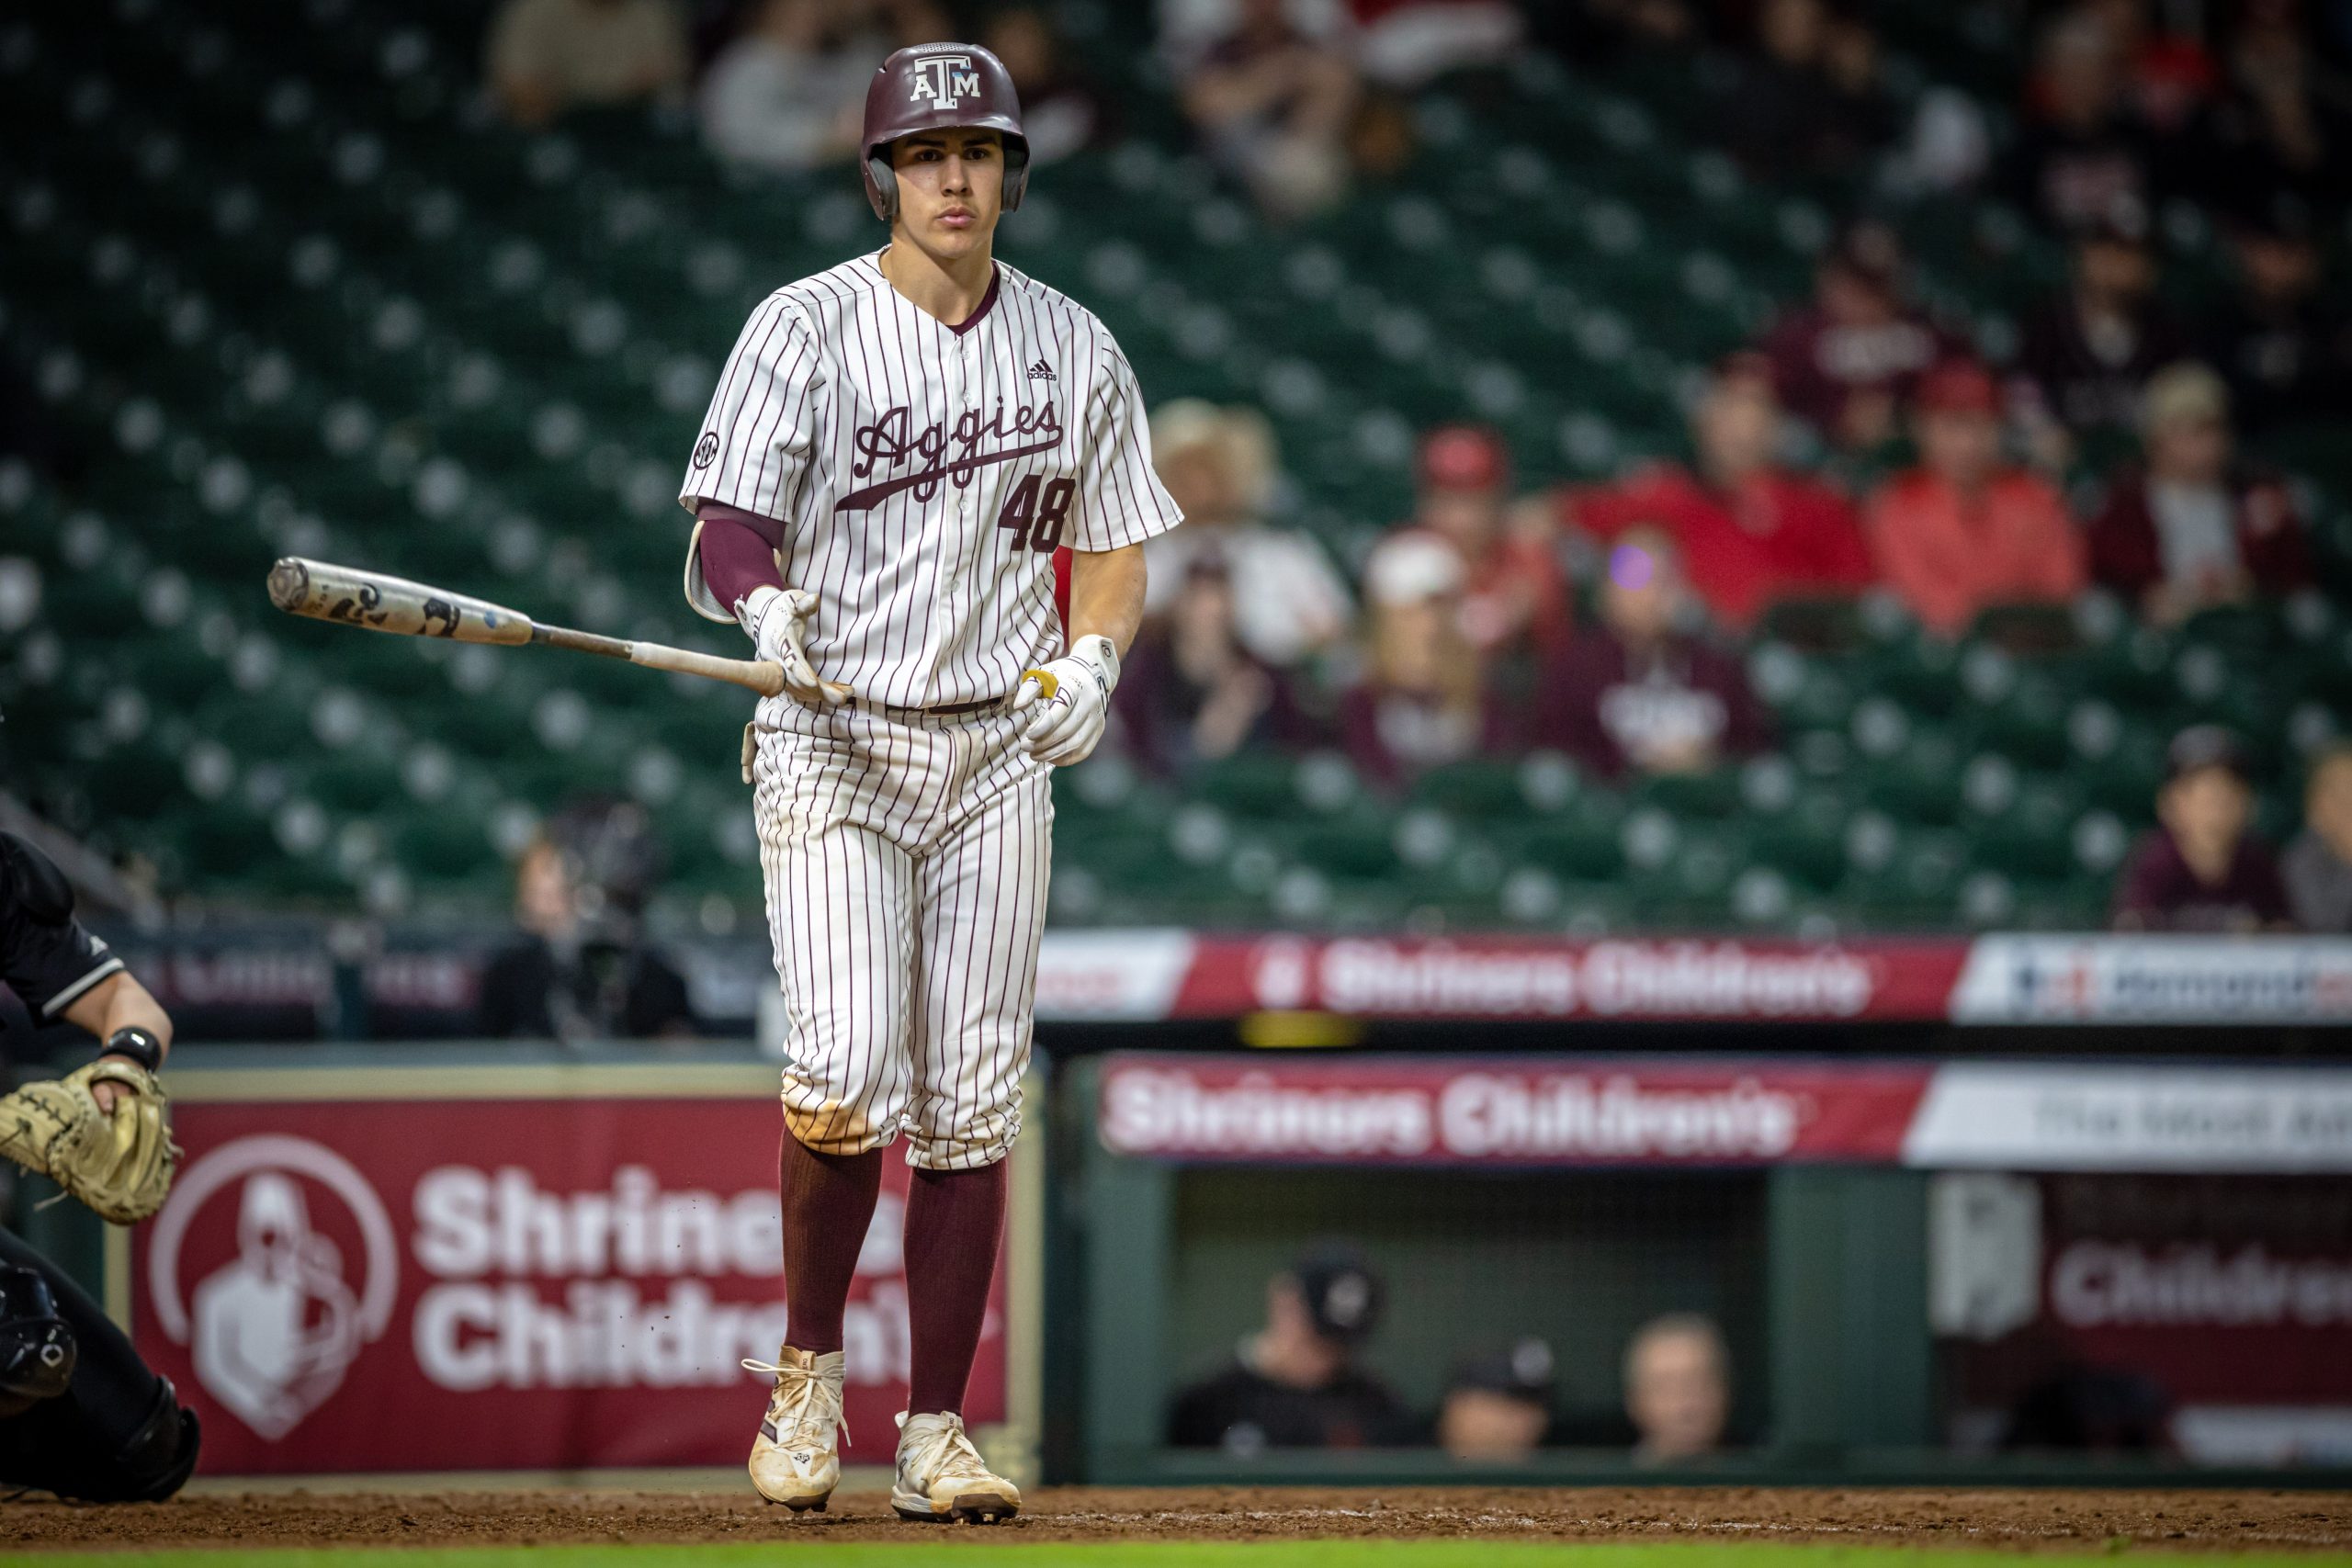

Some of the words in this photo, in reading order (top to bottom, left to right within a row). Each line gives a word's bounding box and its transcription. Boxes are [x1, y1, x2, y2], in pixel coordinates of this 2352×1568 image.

[1027, 371, 1057, 381] adidas
[852, 395, 1063, 503] Aggies
[997, 474, 1077, 553] 48
[1105, 1068, 1436, 1154] Shriners
[1441, 1072, 1796, 1157] Children's
